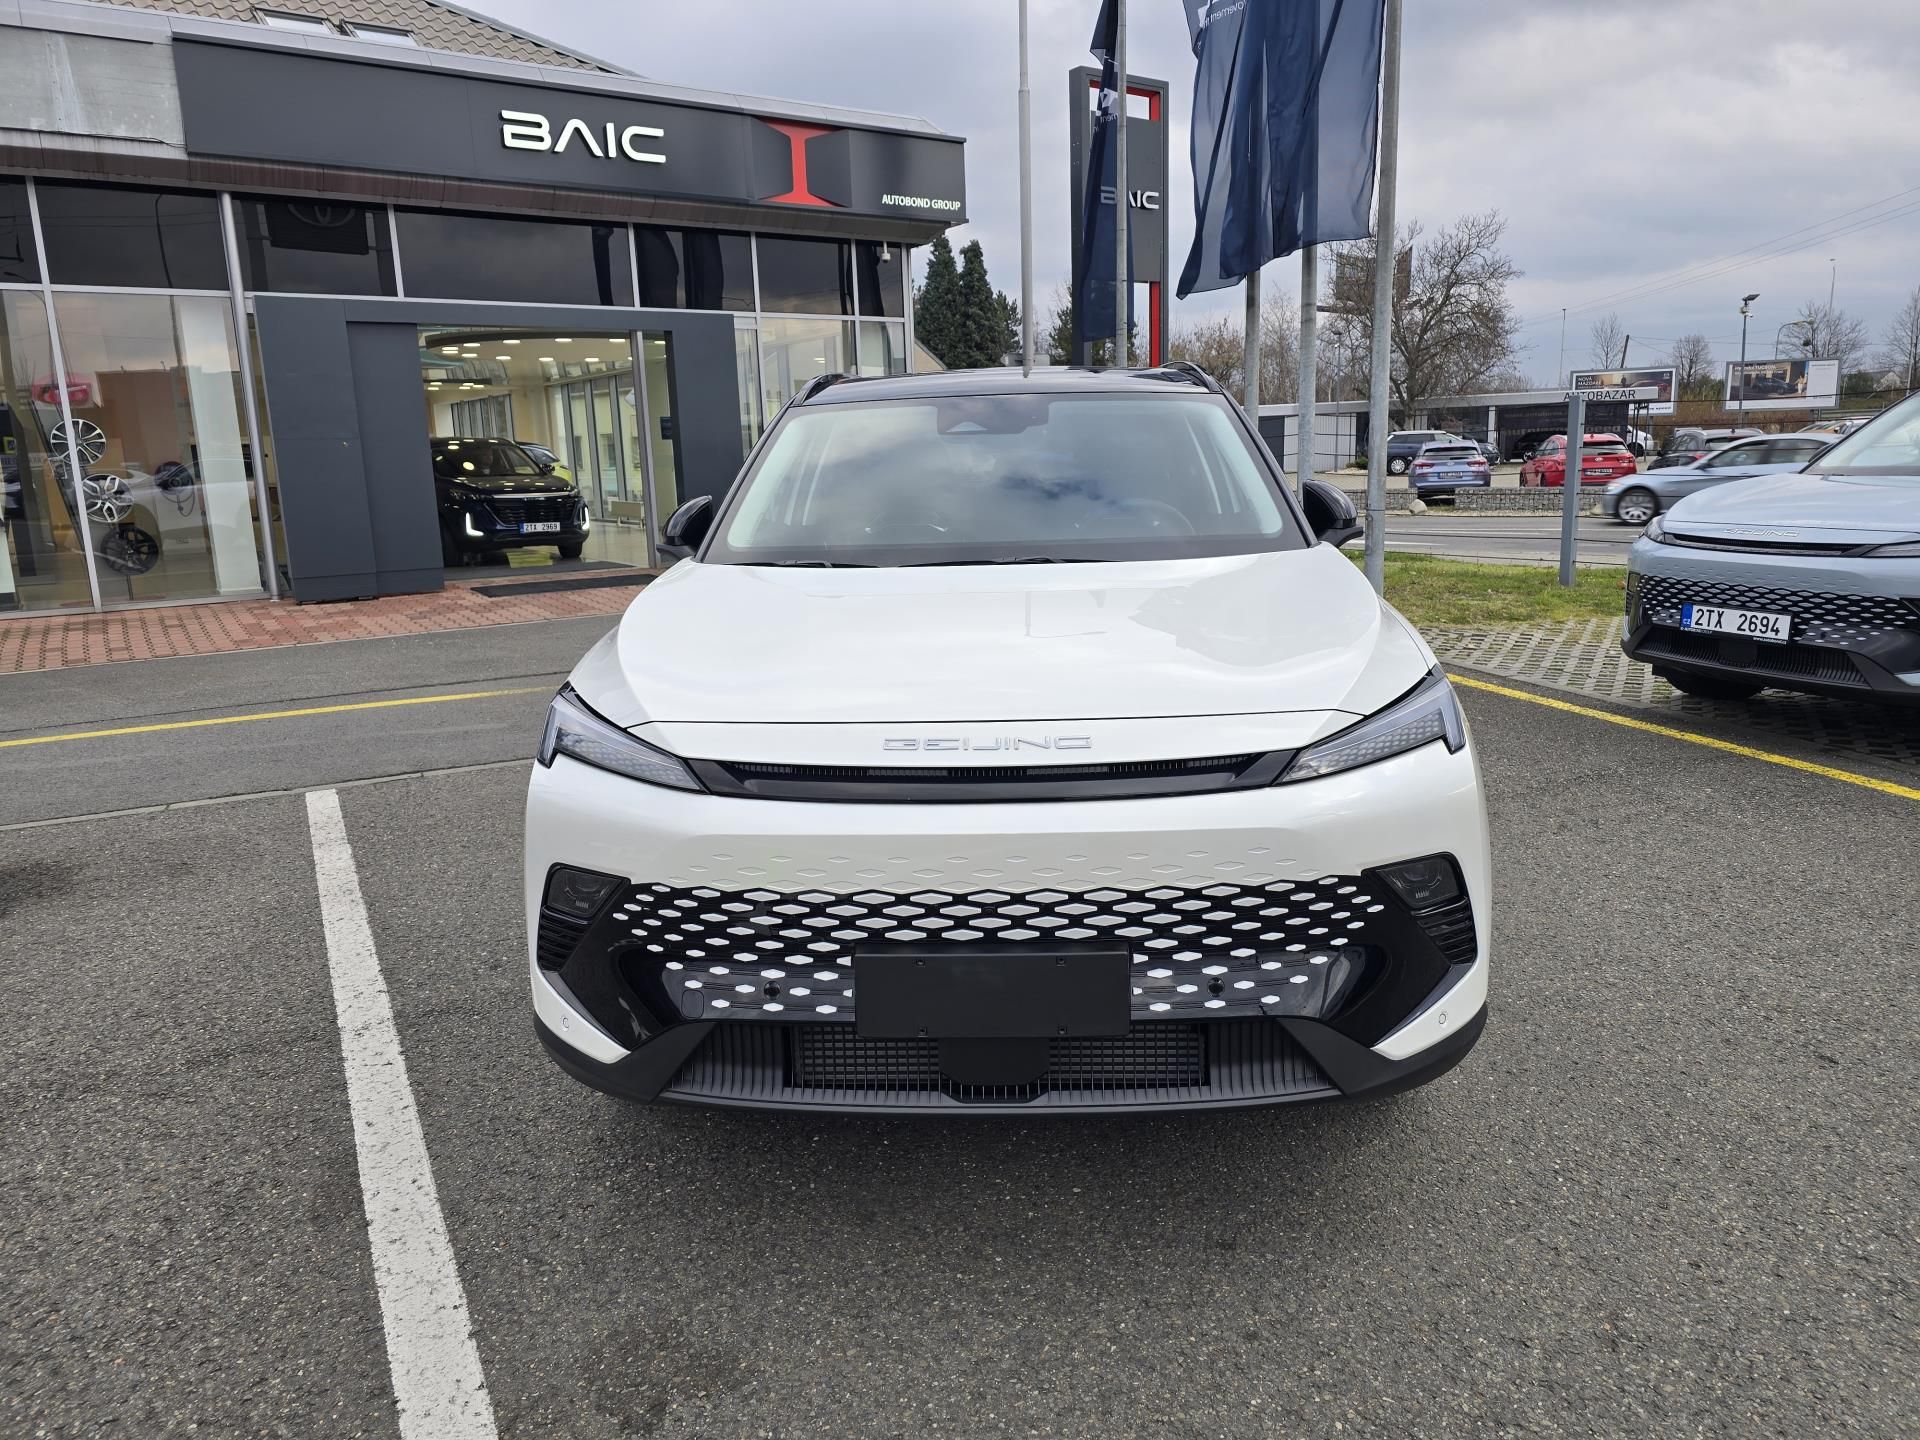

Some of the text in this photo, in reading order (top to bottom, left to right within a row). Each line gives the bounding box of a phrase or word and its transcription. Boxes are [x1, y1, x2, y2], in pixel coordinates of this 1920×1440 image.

[501, 109, 667, 164] BAIC
[881, 194, 961, 211] AUTOBOND GROUP
[1695, 608, 1781, 636] 2TX 2694
[883, 736, 1092, 751] BEIJING
